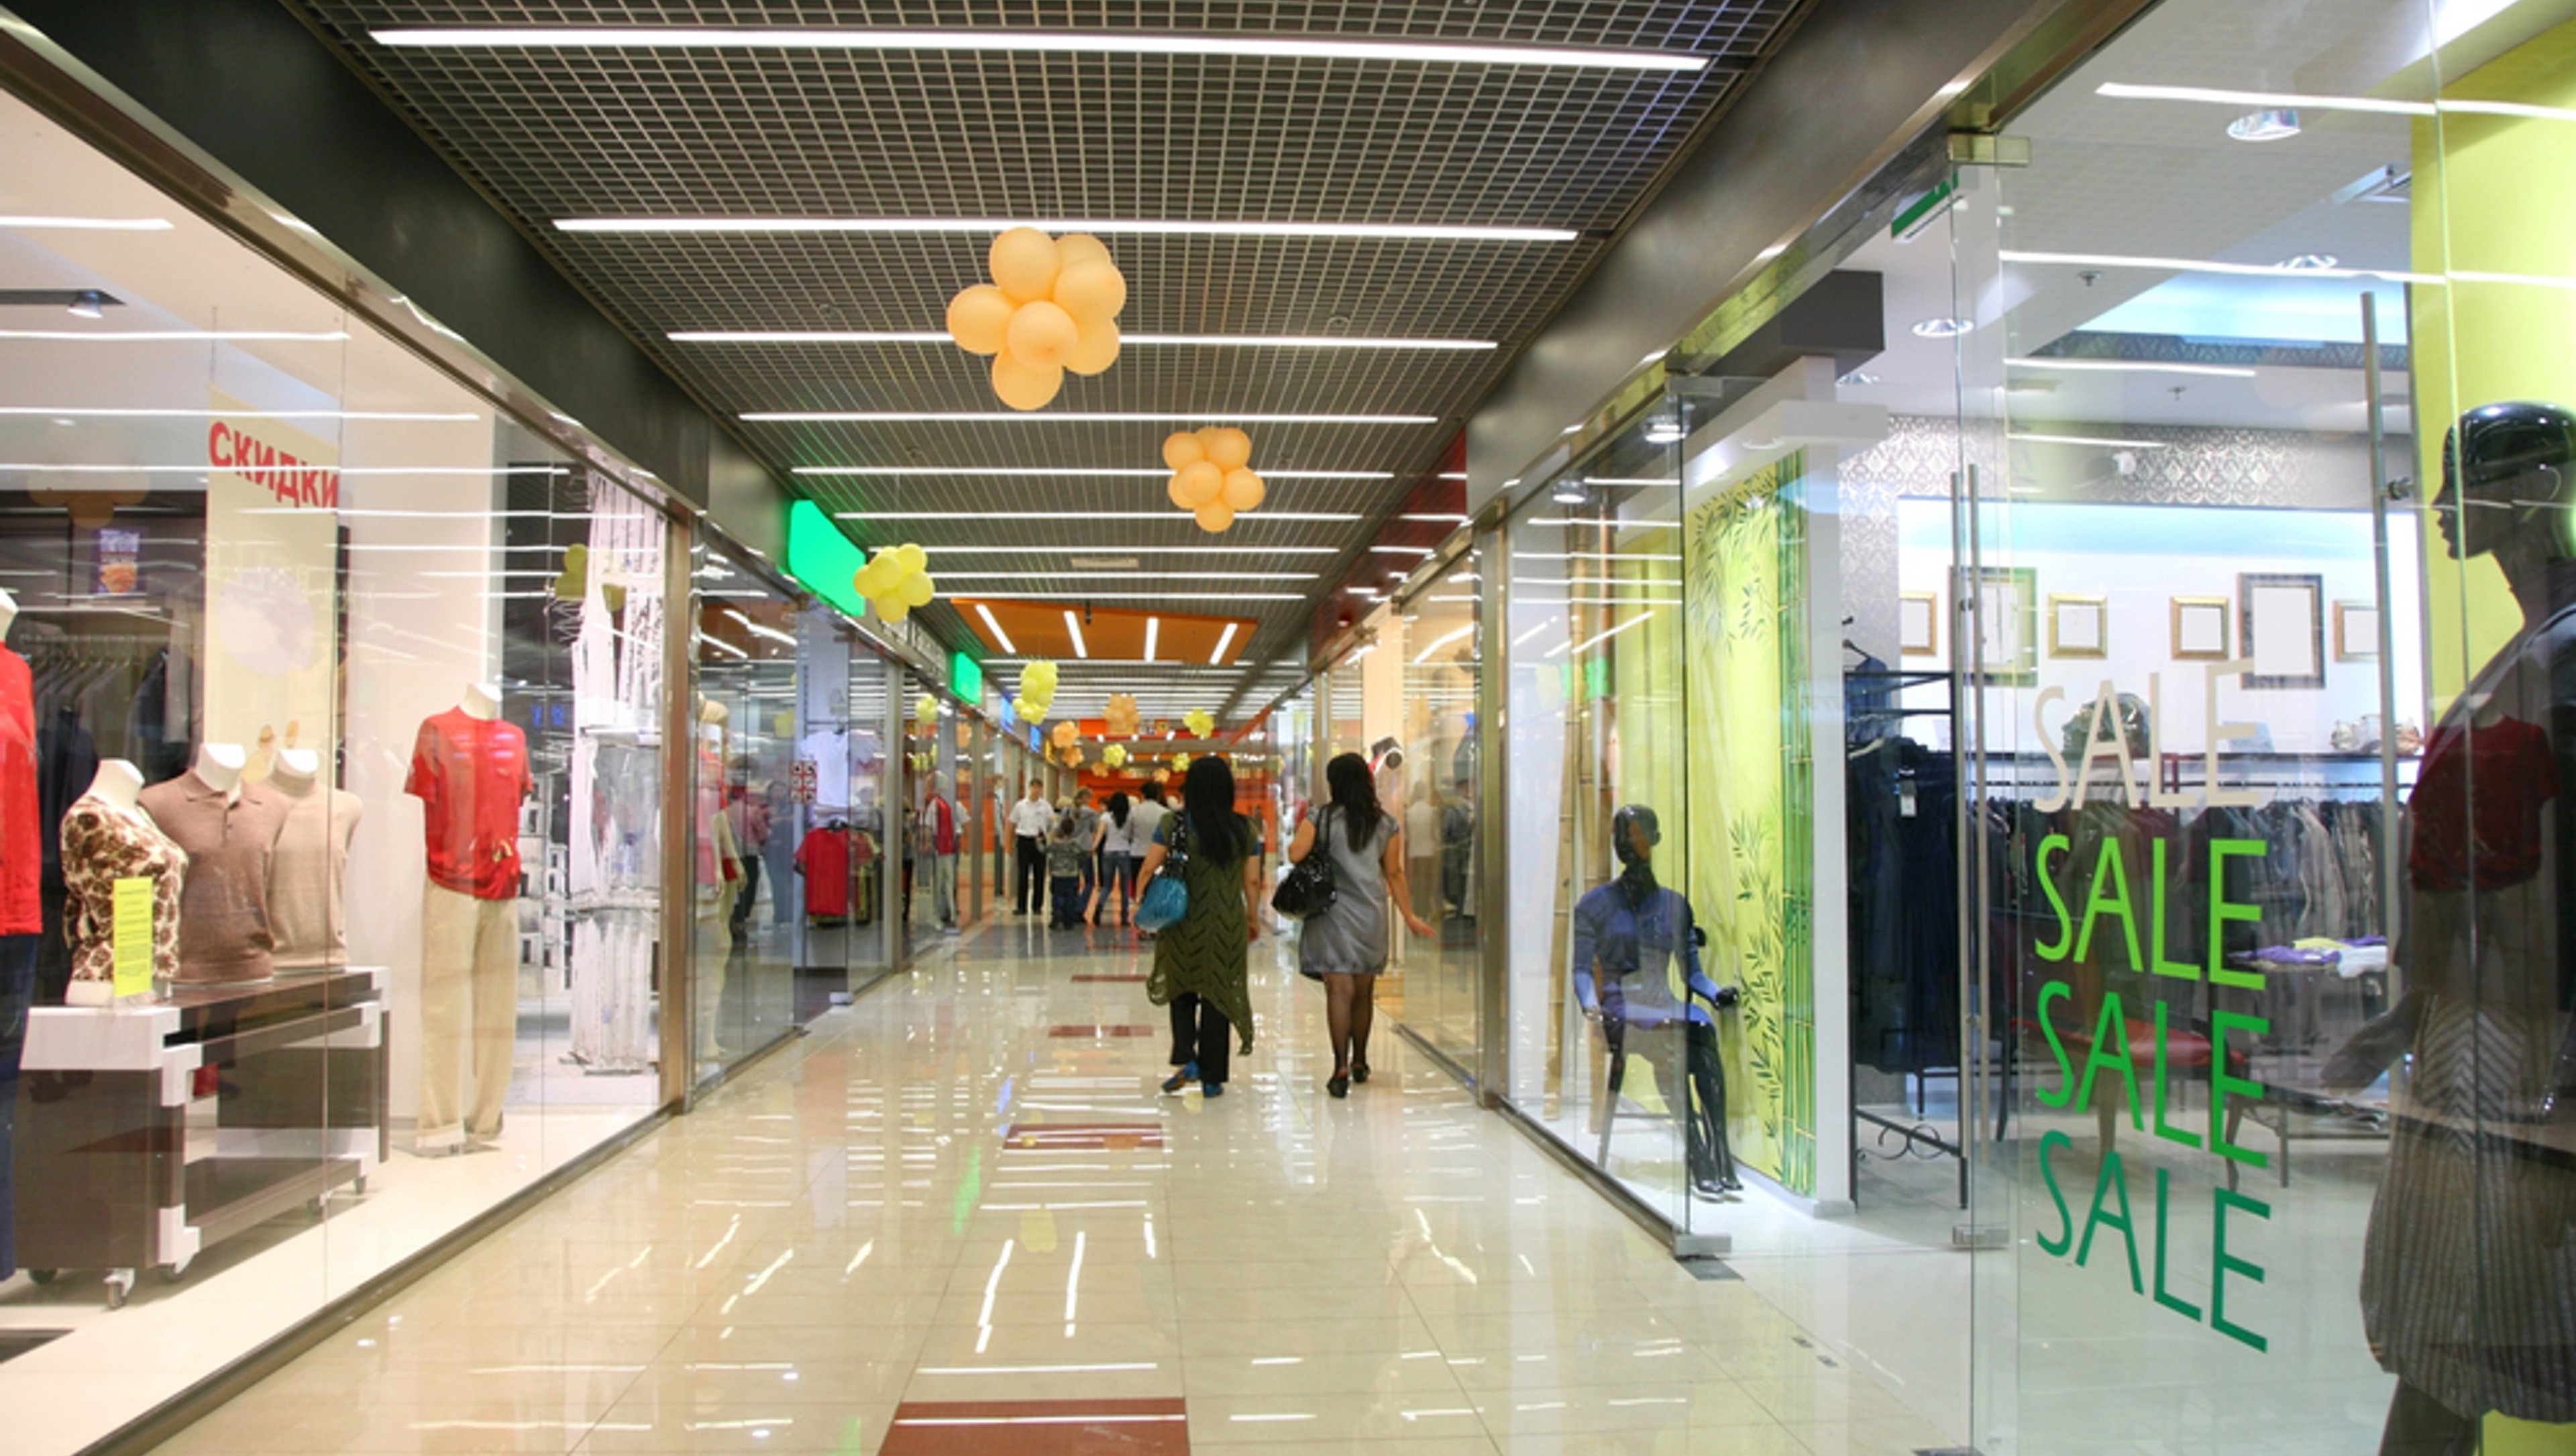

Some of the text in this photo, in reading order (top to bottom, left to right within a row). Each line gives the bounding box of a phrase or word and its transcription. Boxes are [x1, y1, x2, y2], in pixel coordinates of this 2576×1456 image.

[209, 421, 339, 515] СКИДКИ
[2033, 657, 2261, 813] SALE
[2035, 833, 2267, 990] SALE
[2037, 980, 2270, 1168] SALE
[2037, 1130, 2271, 1353] SALE
